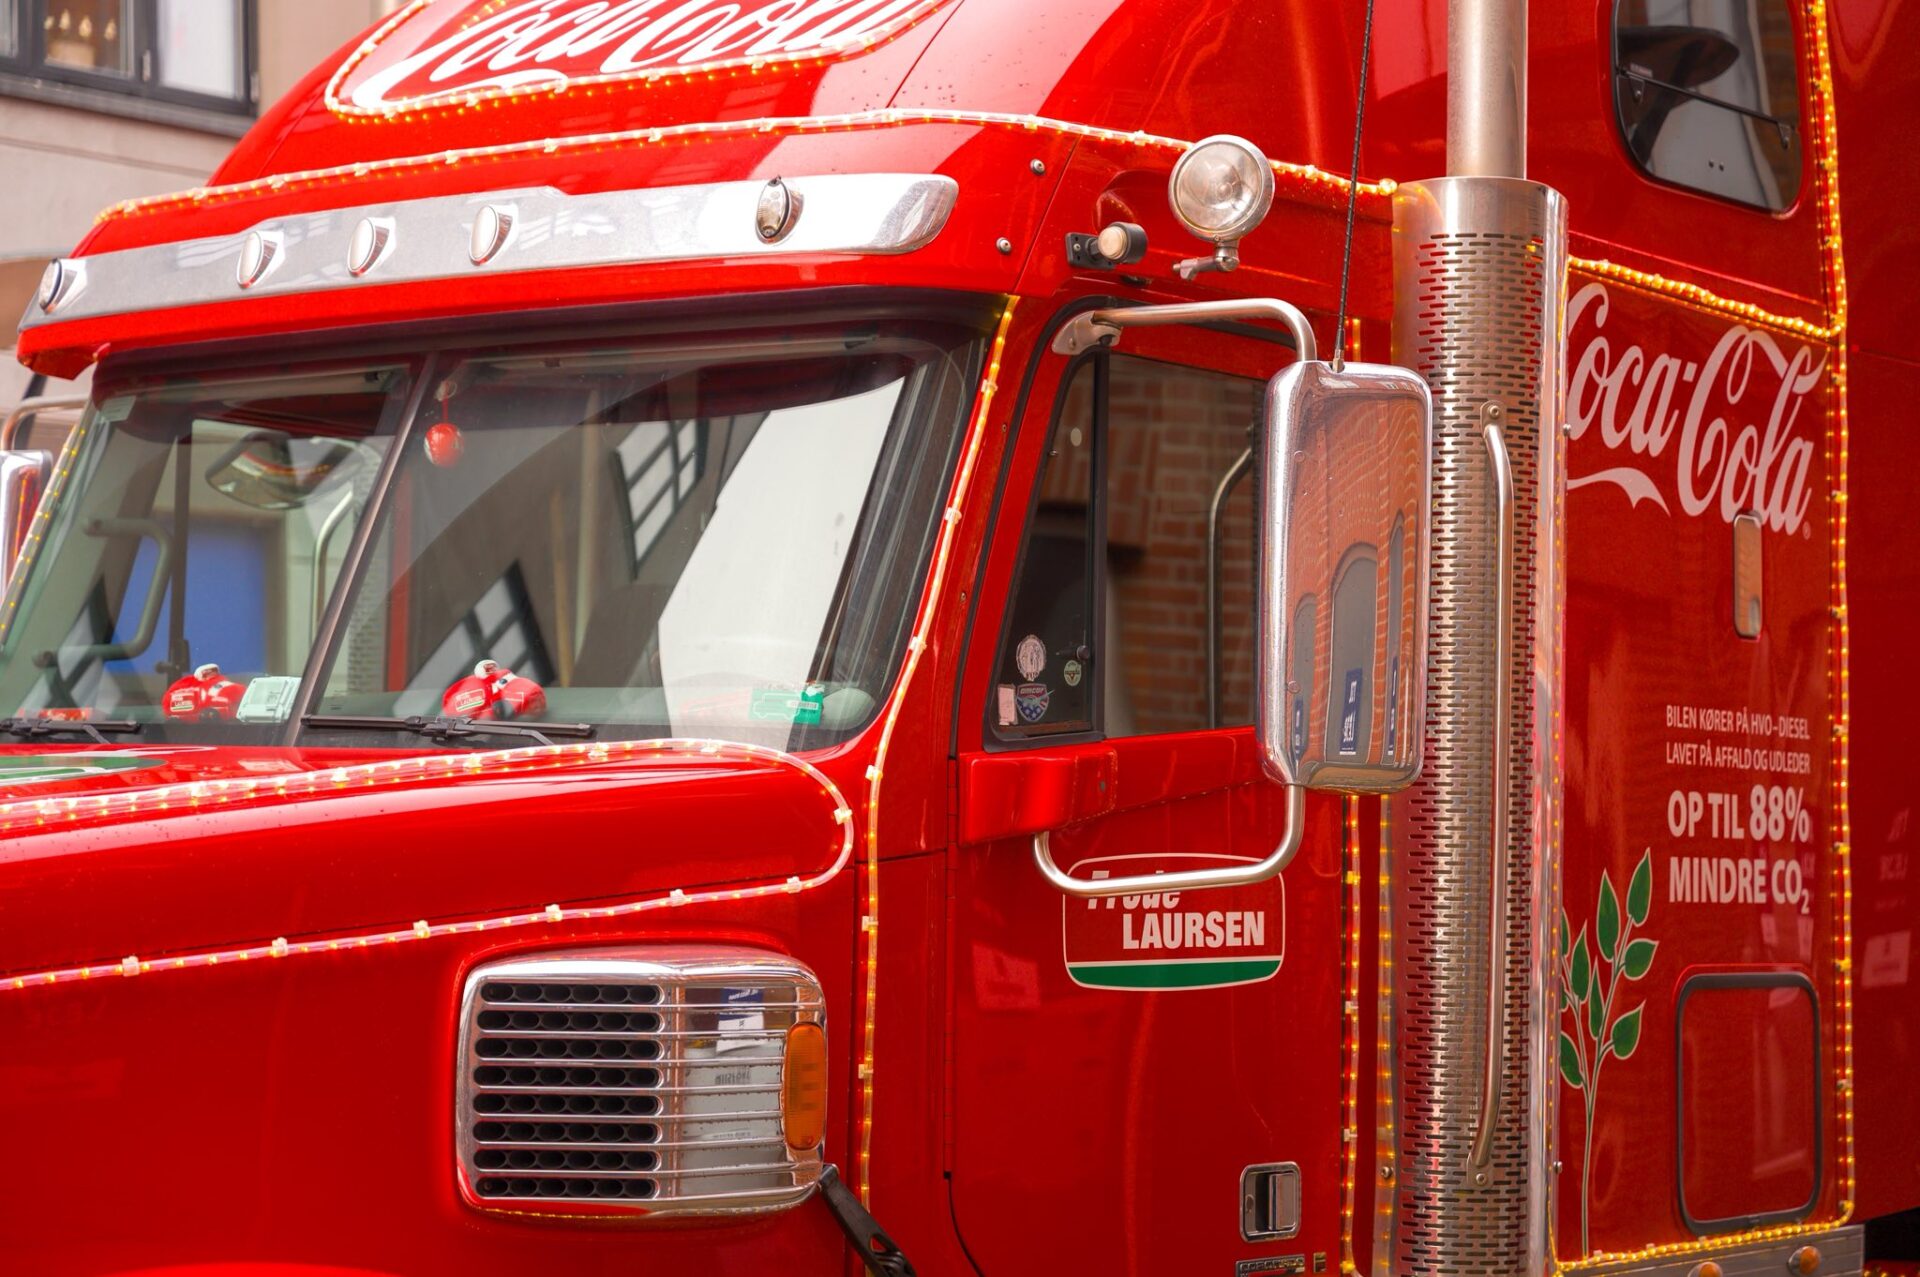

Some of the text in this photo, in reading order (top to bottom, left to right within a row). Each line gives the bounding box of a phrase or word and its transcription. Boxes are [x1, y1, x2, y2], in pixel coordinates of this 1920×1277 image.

[1666, 705, 1697, 729] BILEN
[1699, 709, 1734, 733] KØRER
[1736, 706, 1750, 733] PÅ
[1666, 739, 1811, 774] LAVET PÅ AFFALD OG UDLEDER
[1667, 784, 1810, 843] OP TIL 88%
[1669, 856, 1767, 904] MINDRE
[1123, 911, 1265, 950] LAURSEN
